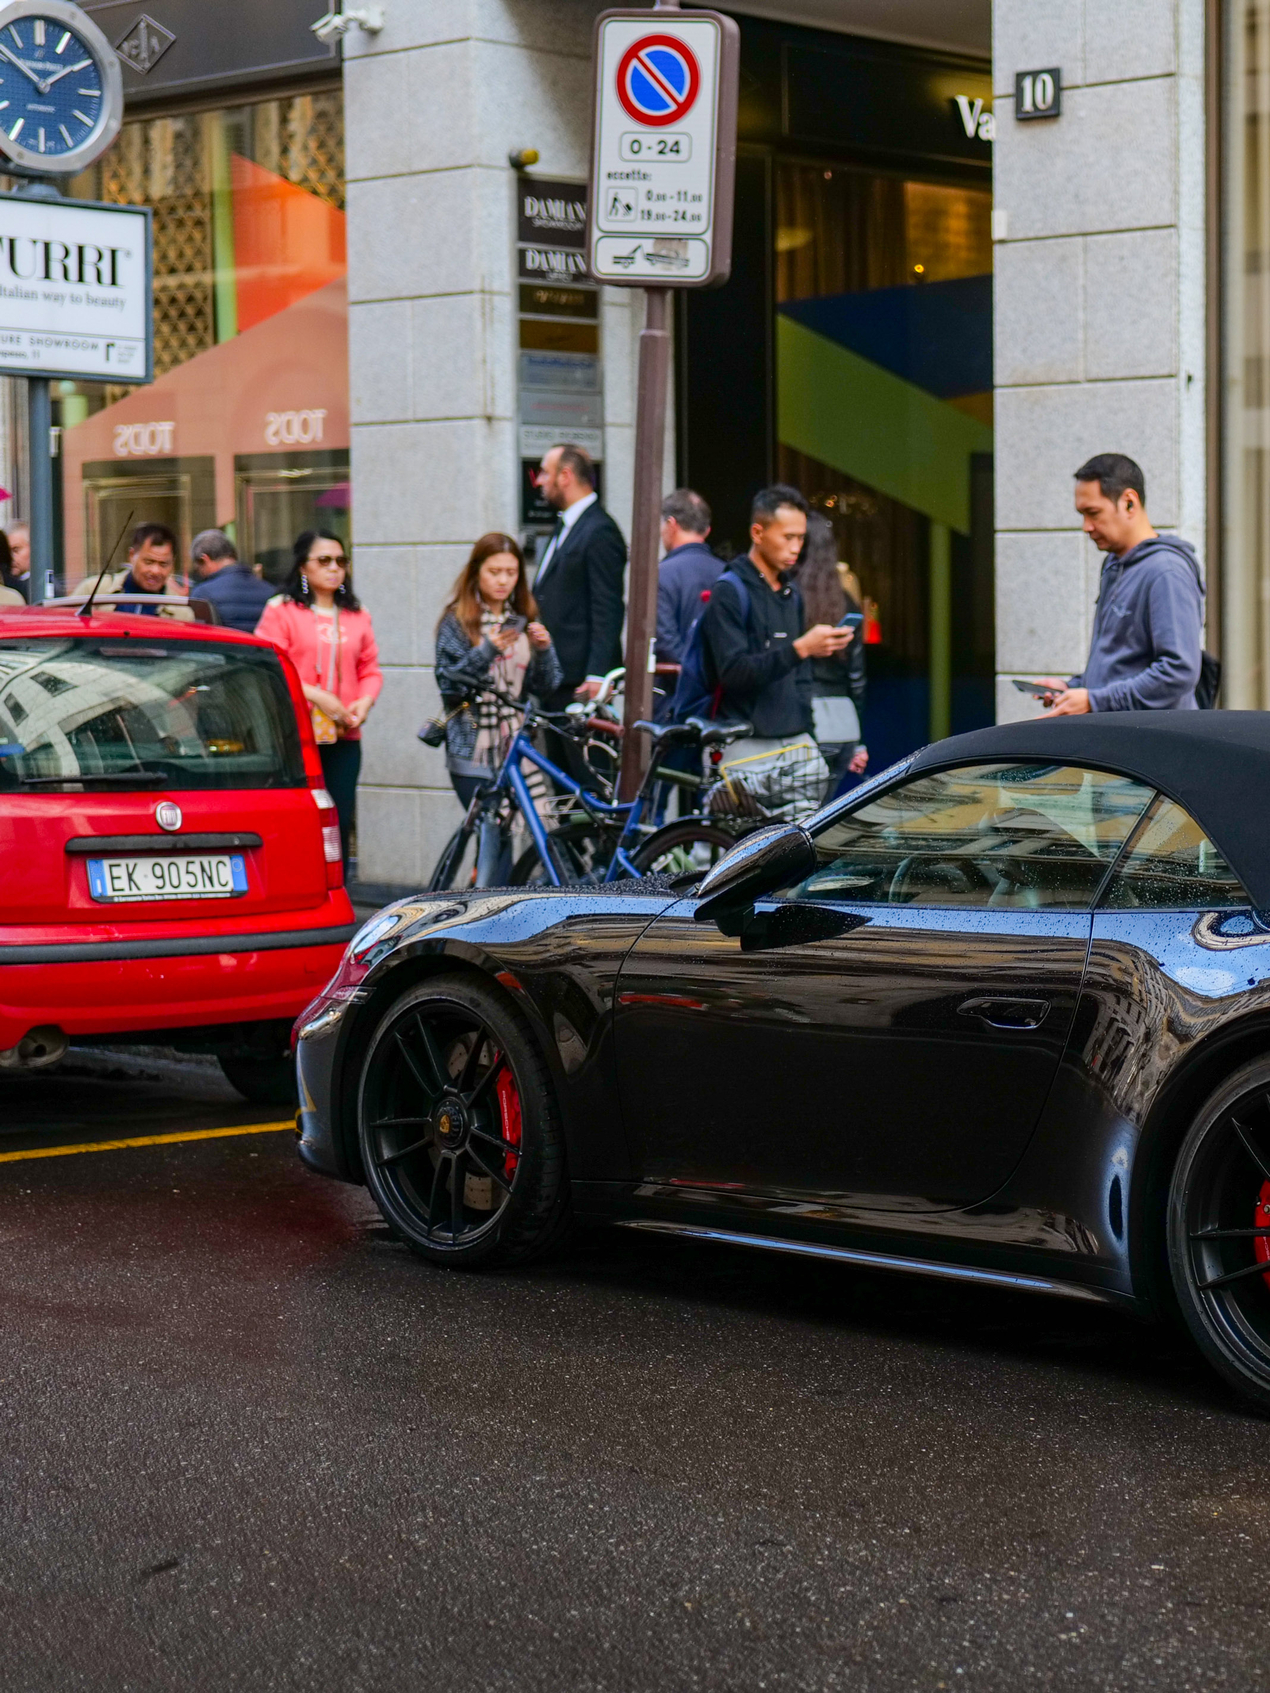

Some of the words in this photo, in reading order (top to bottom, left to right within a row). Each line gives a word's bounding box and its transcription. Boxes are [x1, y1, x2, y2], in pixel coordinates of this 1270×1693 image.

[1020, 72, 1055, 112] 10
[629, 138, 642, 155] 0
[657, 139, 682, 156] 24
[0, 236, 126, 289] URRI
[42, 290, 66, 307] way
[70, 291, 83, 304] to
[86, 291, 126, 313] beauty
[109, 862, 141, 892] EK
[152, 860, 229, 890] 905NC
